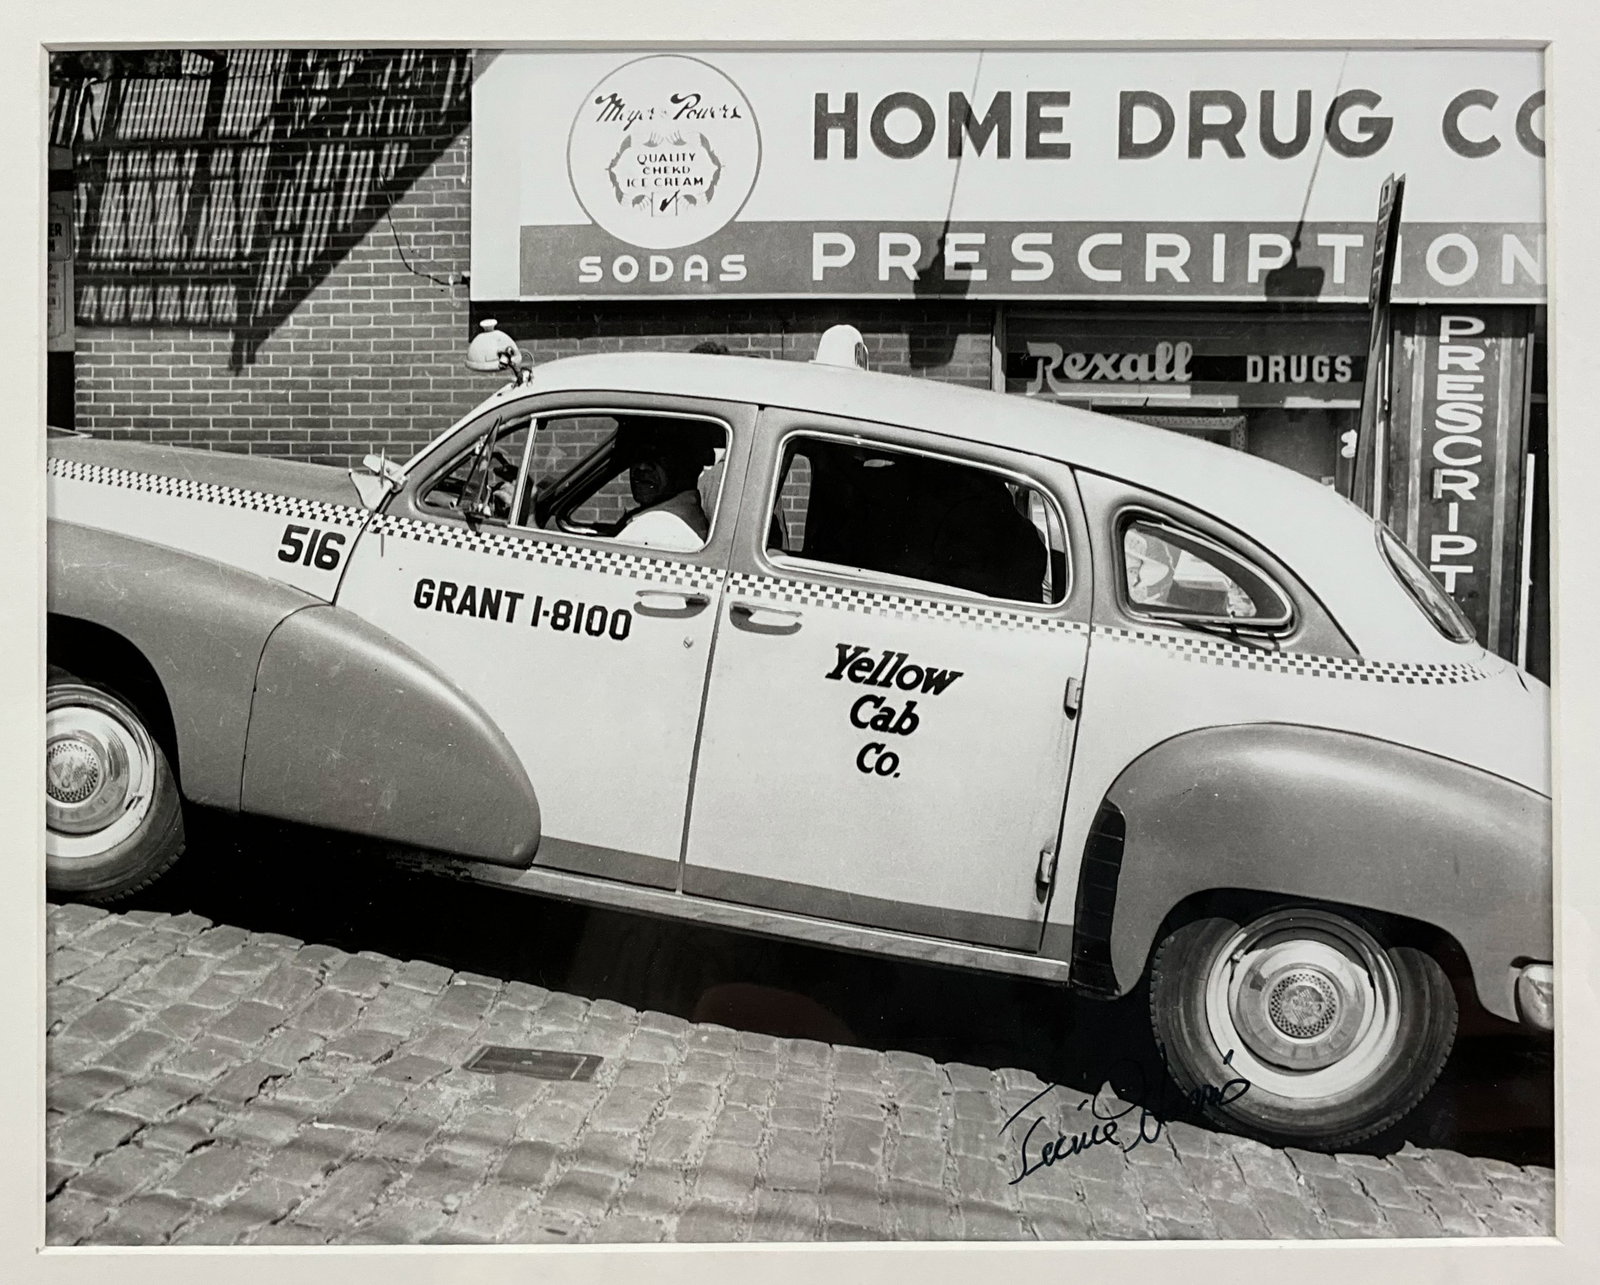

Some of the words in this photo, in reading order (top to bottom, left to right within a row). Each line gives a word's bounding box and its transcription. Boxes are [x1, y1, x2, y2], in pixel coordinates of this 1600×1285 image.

[813, 91, 1071, 160] HOME
[1118, 89, 1394, 160] DRUG
[636, 152, 697, 166] QUALITY
[642, 165, 691, 175] CHEKD
[626, 177, 648, 188] ICE
[653, 176, 704, 188] CREAM
[578, 254, 748, 284] SODAS
[1027, 341, 1193, 398] Rexall
[1246, 355, 1353, 384] DRUGS
[277, 523, 347, 571] 516
[413, 578, 524, 624] GRANT
[825, 642, 964, 696] Yellow
[849, 694, 920, 736] Cab
[856, 741, 901, 779] Co.
